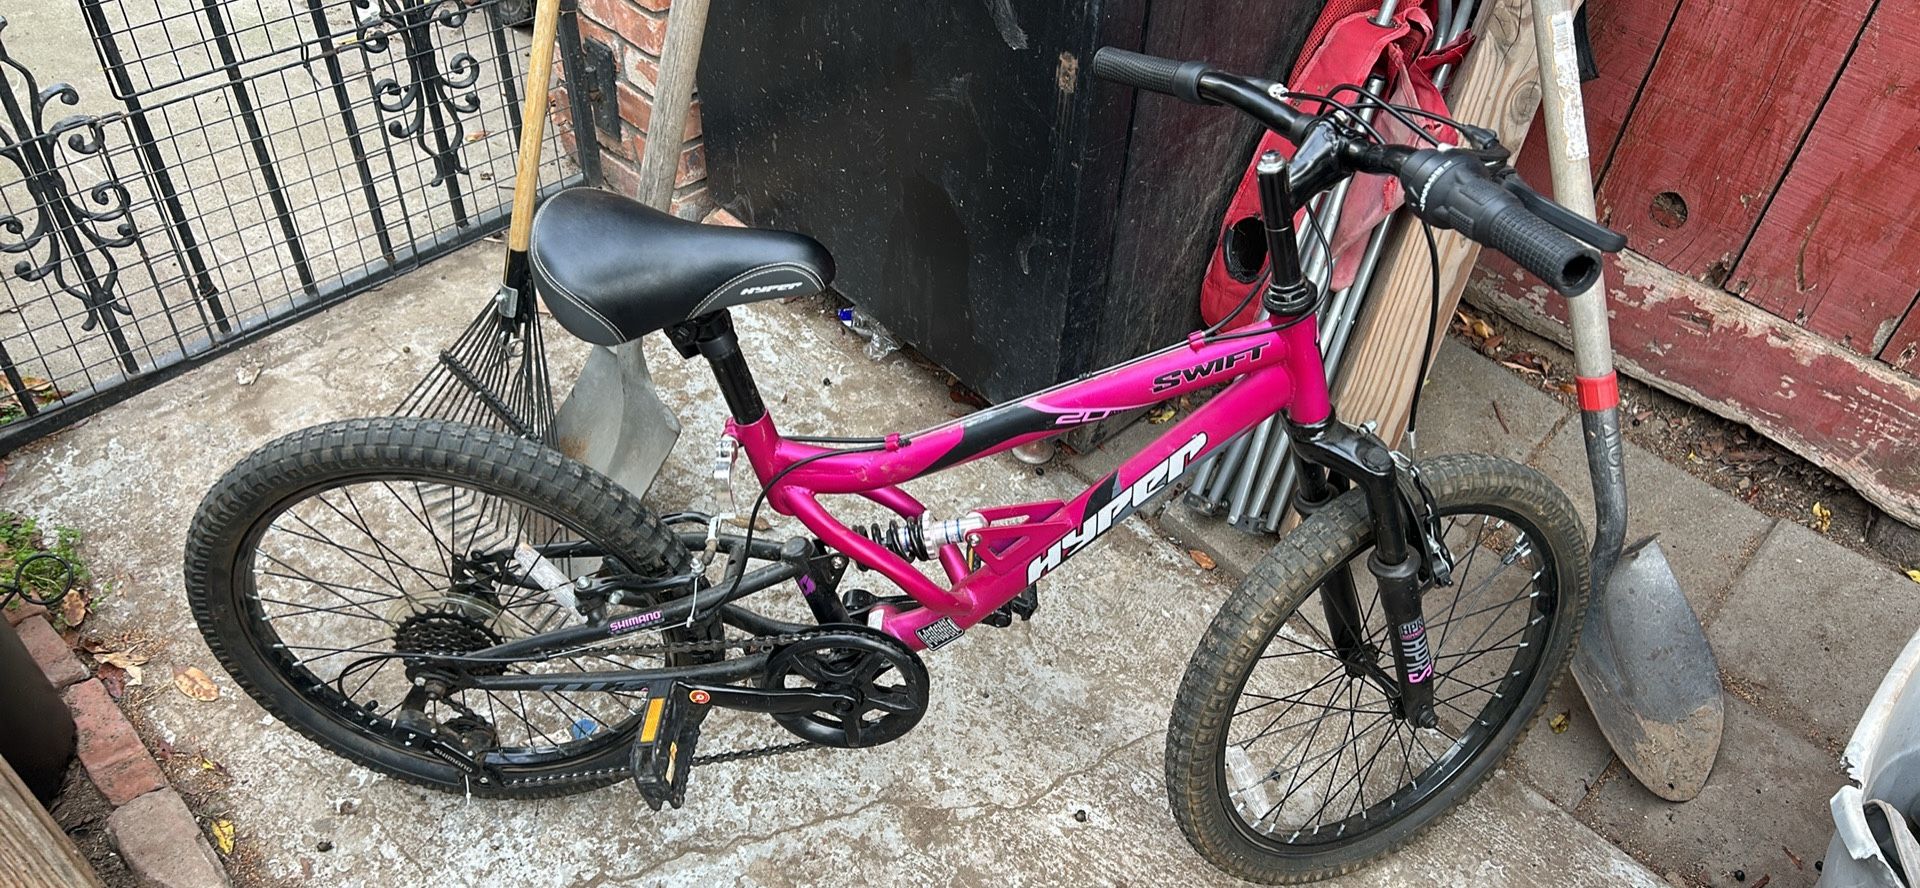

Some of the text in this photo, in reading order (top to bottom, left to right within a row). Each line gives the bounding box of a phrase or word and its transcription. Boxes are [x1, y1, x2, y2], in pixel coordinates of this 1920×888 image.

[1151, 340, 1271, 395] SWIFT
[610, 610, 662, 631] SHIMANO
[1401, 632, 1433, 683] HPRS
